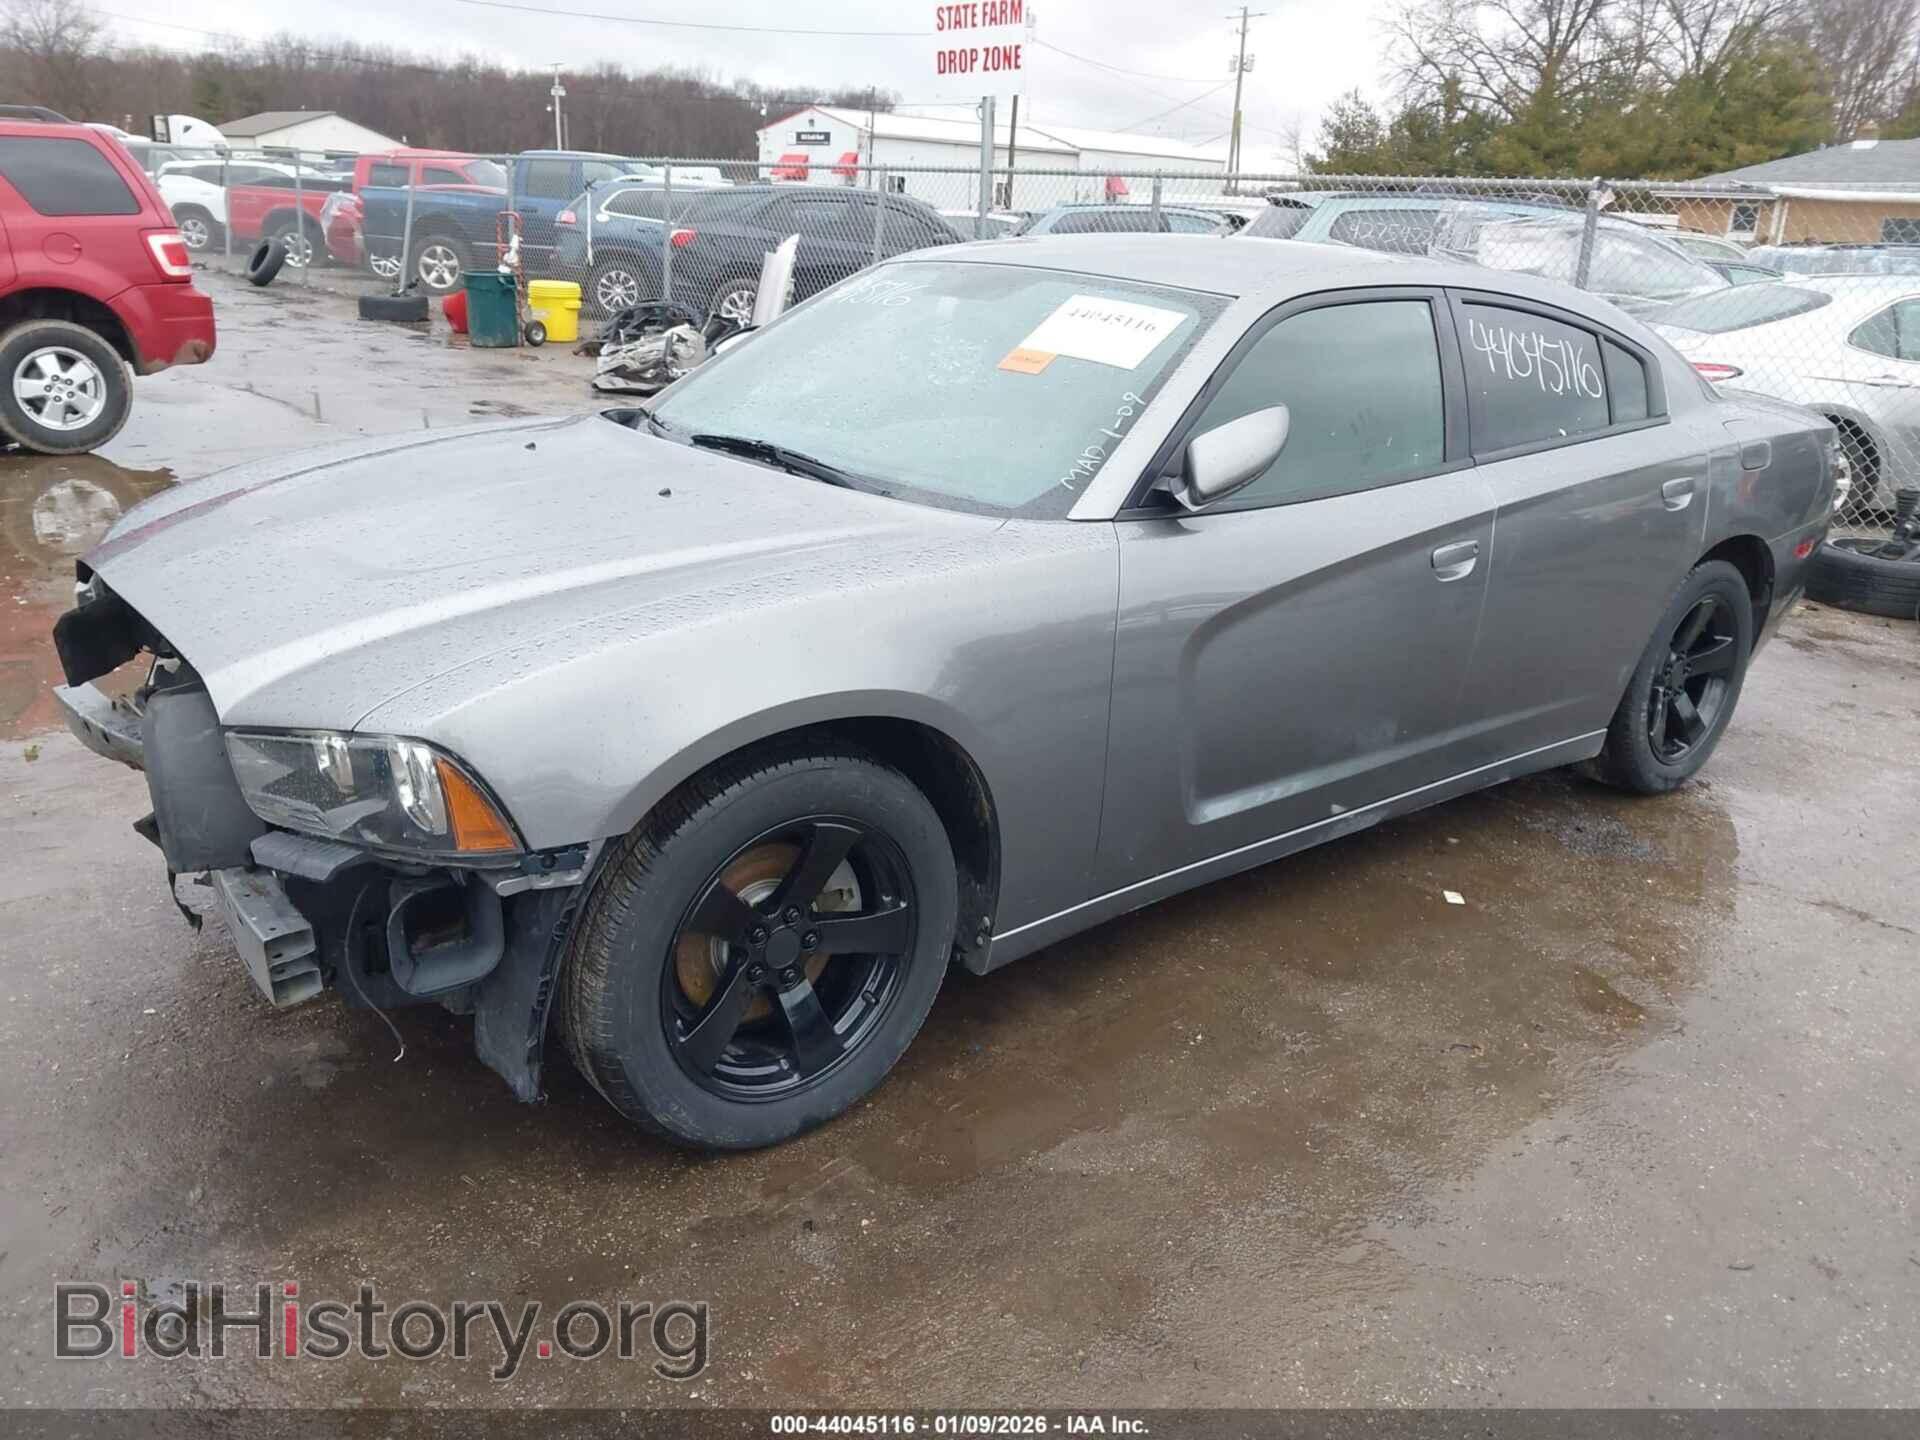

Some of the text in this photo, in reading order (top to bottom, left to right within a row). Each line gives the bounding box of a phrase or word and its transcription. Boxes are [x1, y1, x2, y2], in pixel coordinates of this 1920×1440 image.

[936, 0, 1023, 31] STATE FARM
[937, 44, 1022, 75] DROP ZONE
[1468, 318, 1603, 398] 44045116
